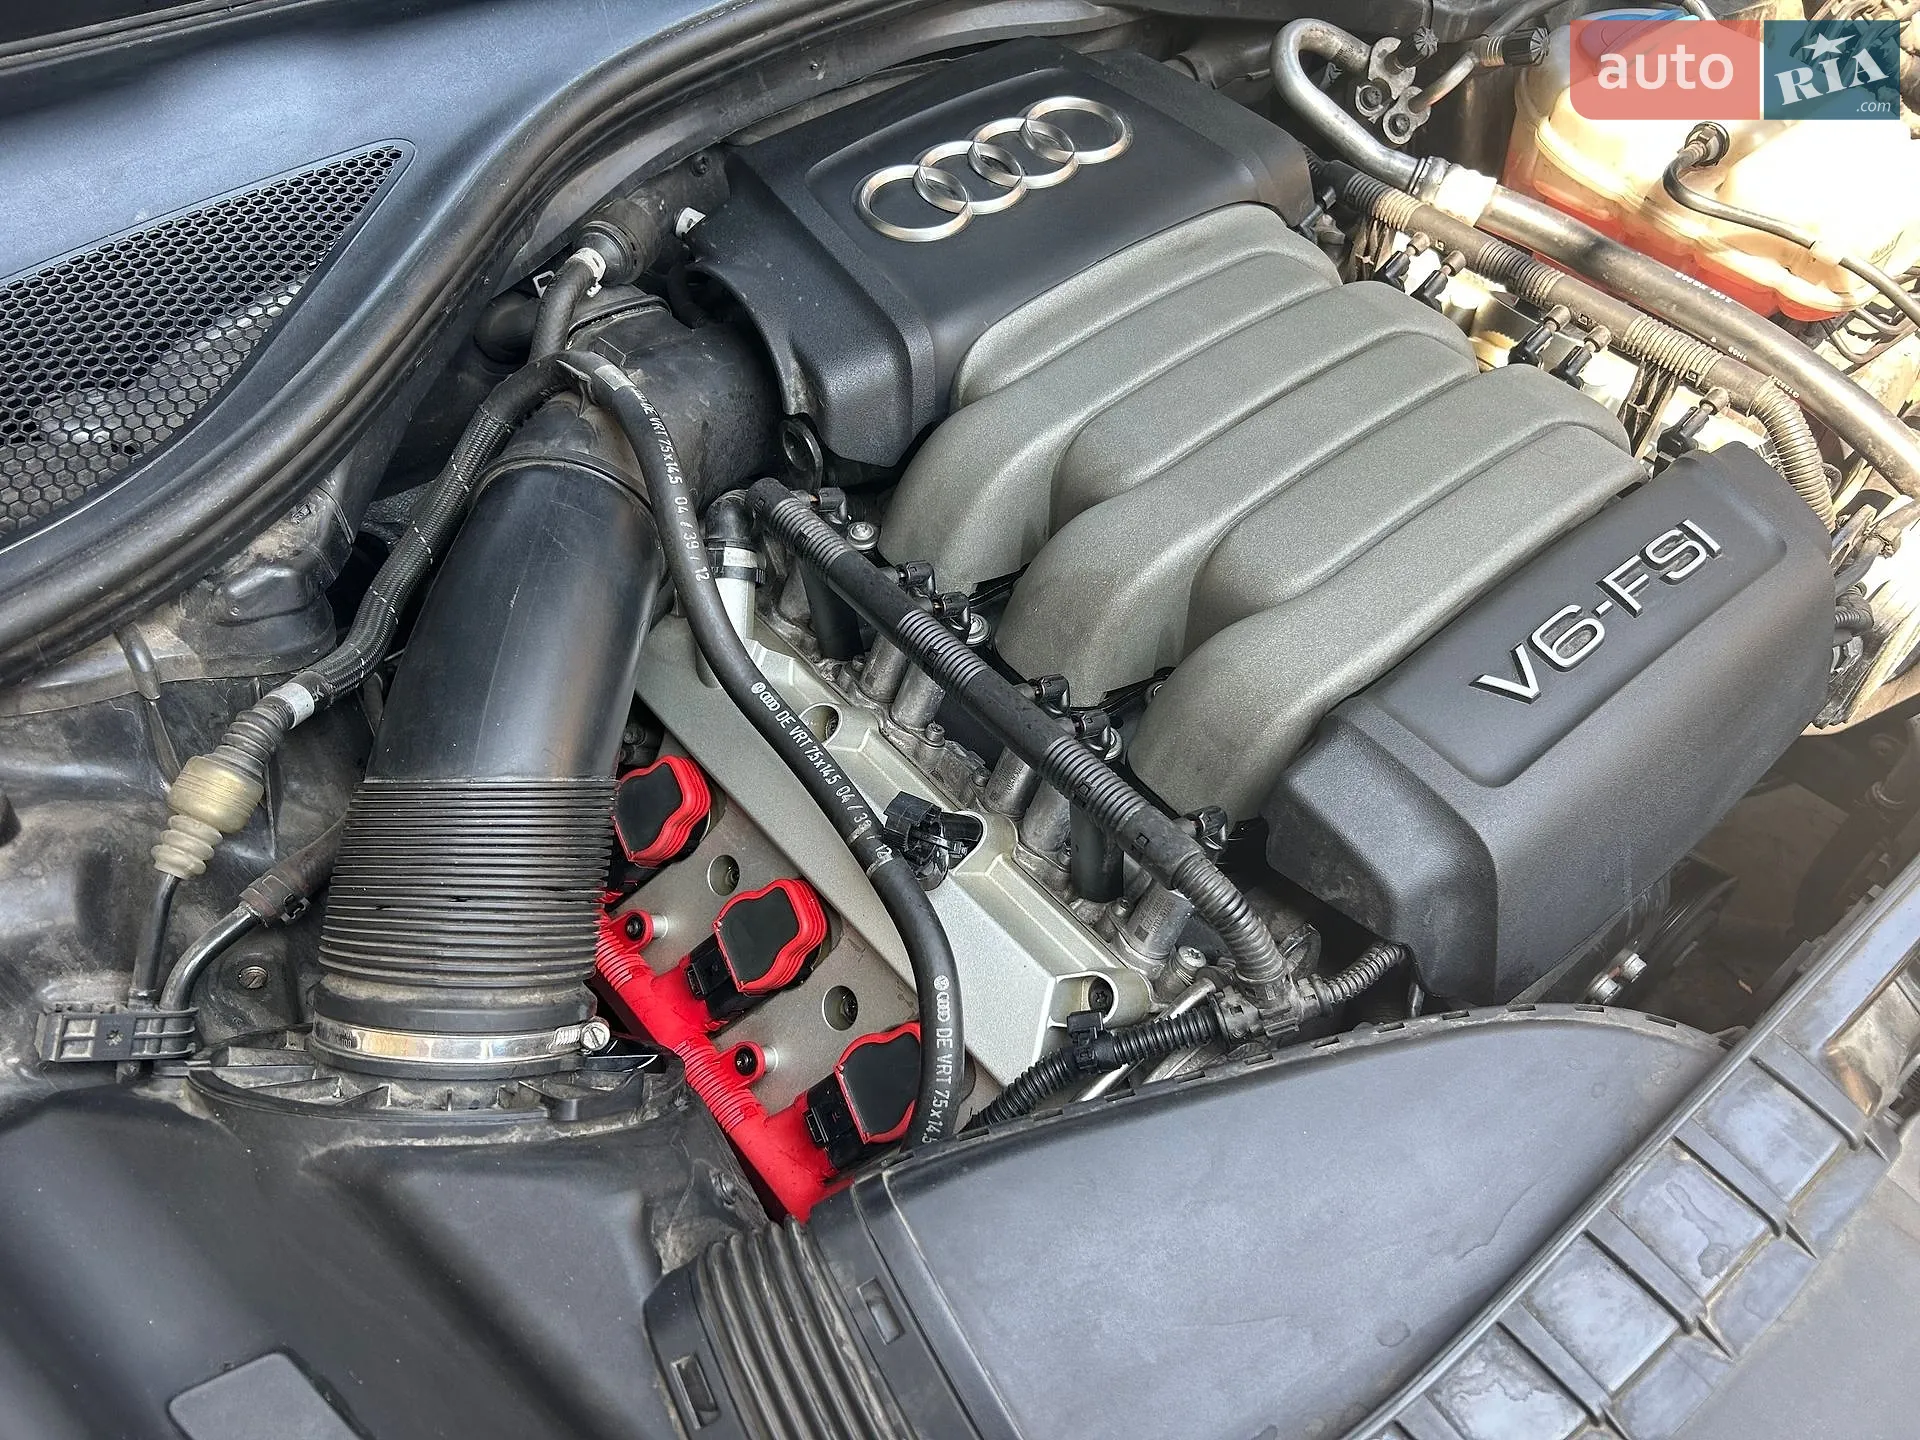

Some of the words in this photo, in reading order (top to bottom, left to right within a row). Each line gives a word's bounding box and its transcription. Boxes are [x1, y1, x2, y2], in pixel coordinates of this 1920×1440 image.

[640, 402, 657, 416] DE
[649, 416, 668, 442] VRT
[674, 496, 689, 514] 04
[682, 531, 700, 550] 39
[694, 566, 710, 582] 12
[1469, 519, 1722, 705] V6-FSI
[775, 710, 796, 729] DE
[788, 725, 812, 748] VRT
[835, 785, 856, 804] 04
[936, 1027, 953, 1049] DE
[936, 1053, 953, 1085] VRT
